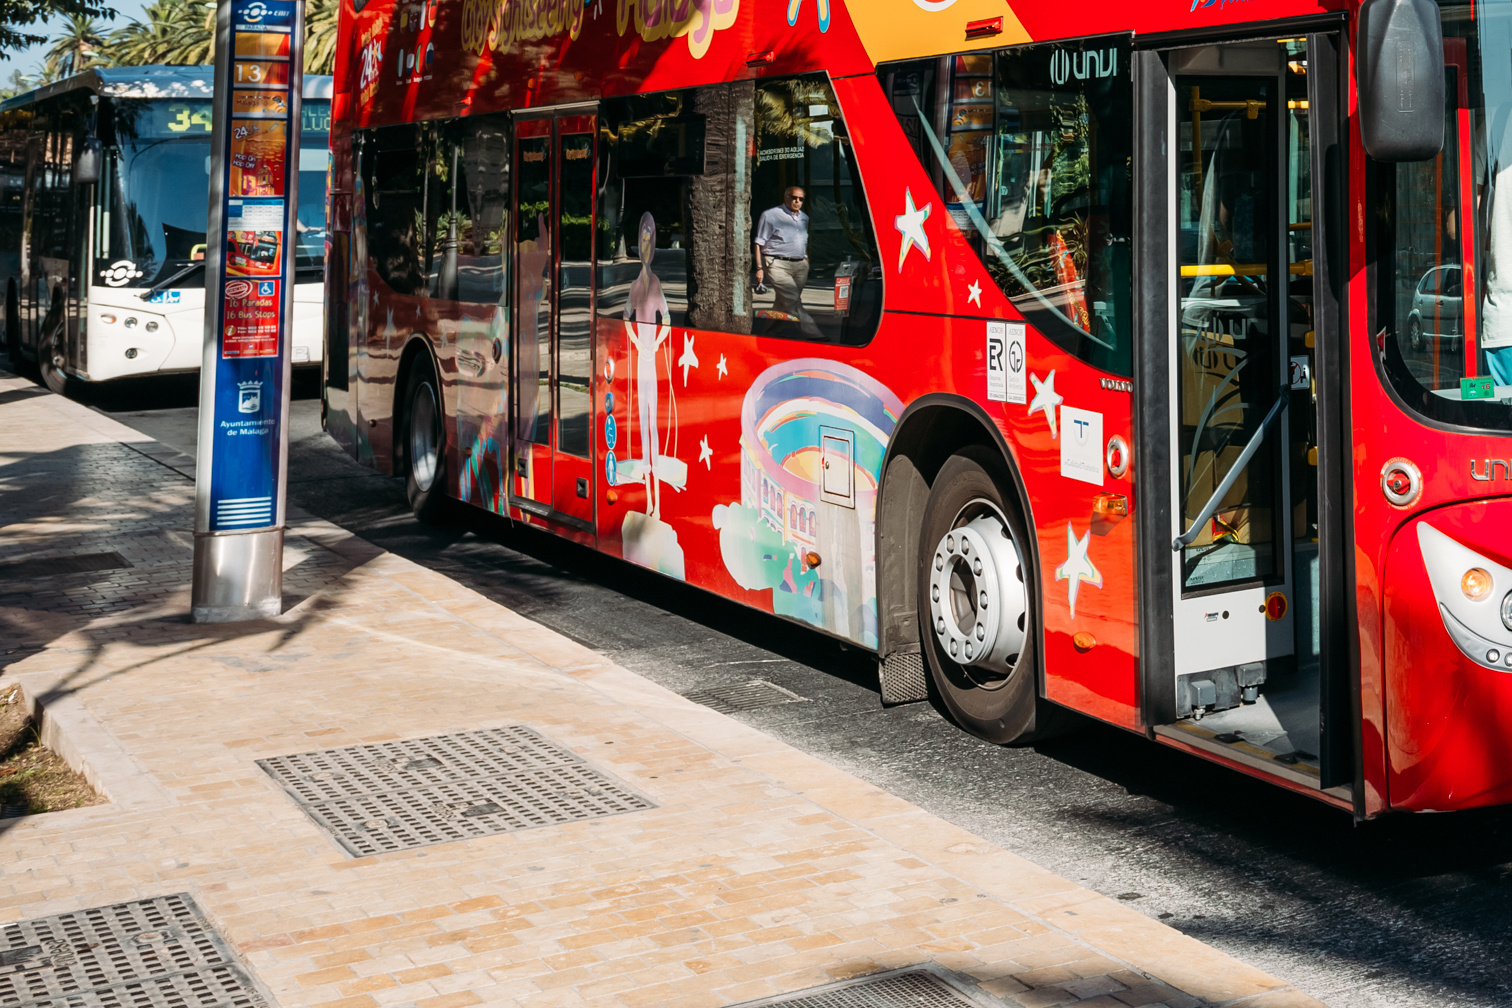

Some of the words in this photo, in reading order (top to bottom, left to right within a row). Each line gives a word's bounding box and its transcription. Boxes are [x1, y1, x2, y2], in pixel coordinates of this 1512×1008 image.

[236, 64, 261, 82] 13
[168, 103, 212, 132] 34
[234, 126, 248, 139] 24
[229, 299, 239, 308] 16
[241, 299, 273, 307] Paradas
[226, 310, 236, 319] 16
[238, 310, 252, 318] Bus
[254, 310, 276, 319] Stops
[1099, 378, 1134, 393] VOLVO
[220, 419, 276, 428] Ayuntamiento
